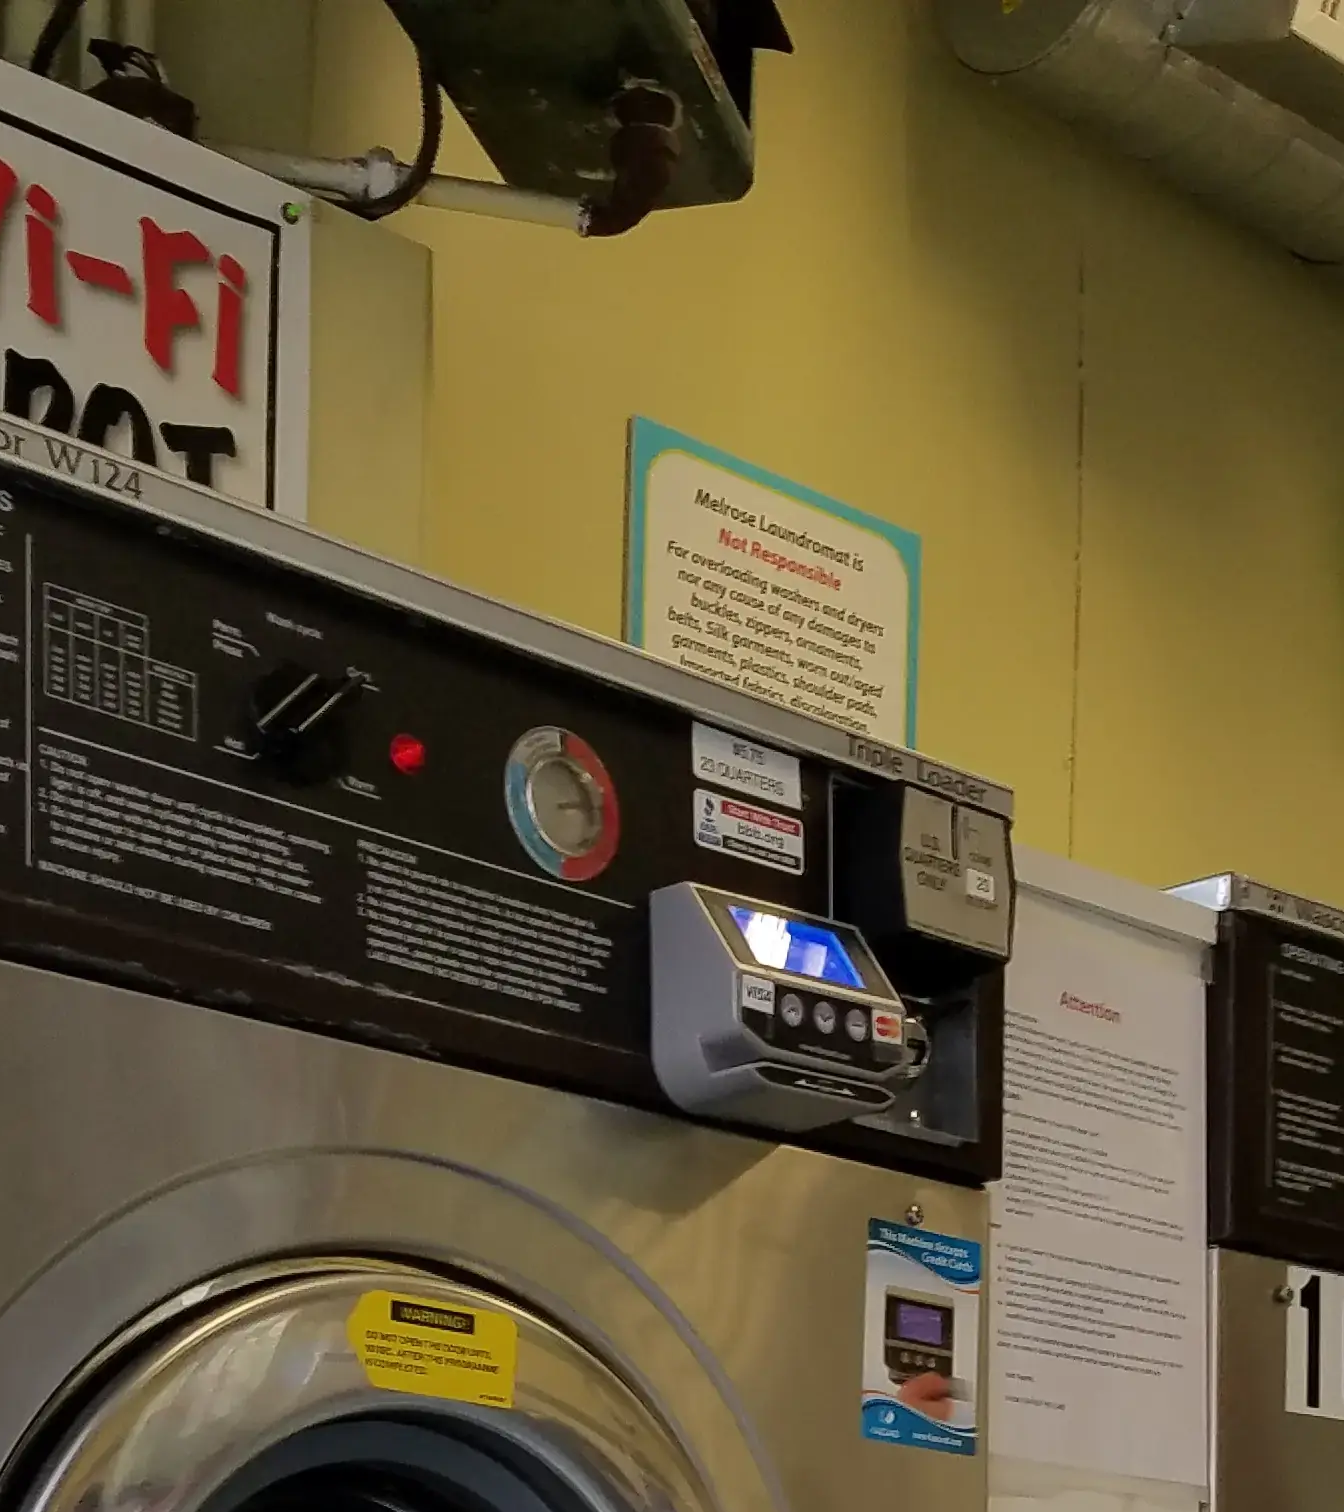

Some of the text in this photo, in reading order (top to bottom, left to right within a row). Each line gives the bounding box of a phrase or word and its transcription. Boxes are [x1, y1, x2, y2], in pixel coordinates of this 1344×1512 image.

[44, 438, 143, 499] W124
[694, 488, 864, 572] Melrose Laundromat is
[718, 528, 842, 591] Not Responsible
[667, 540, 885, 637] For overloading washers and dryers
[677, 569, 876, 655] nor any cause of any damages to
[718, 761, 784, 796] QUARTERS
